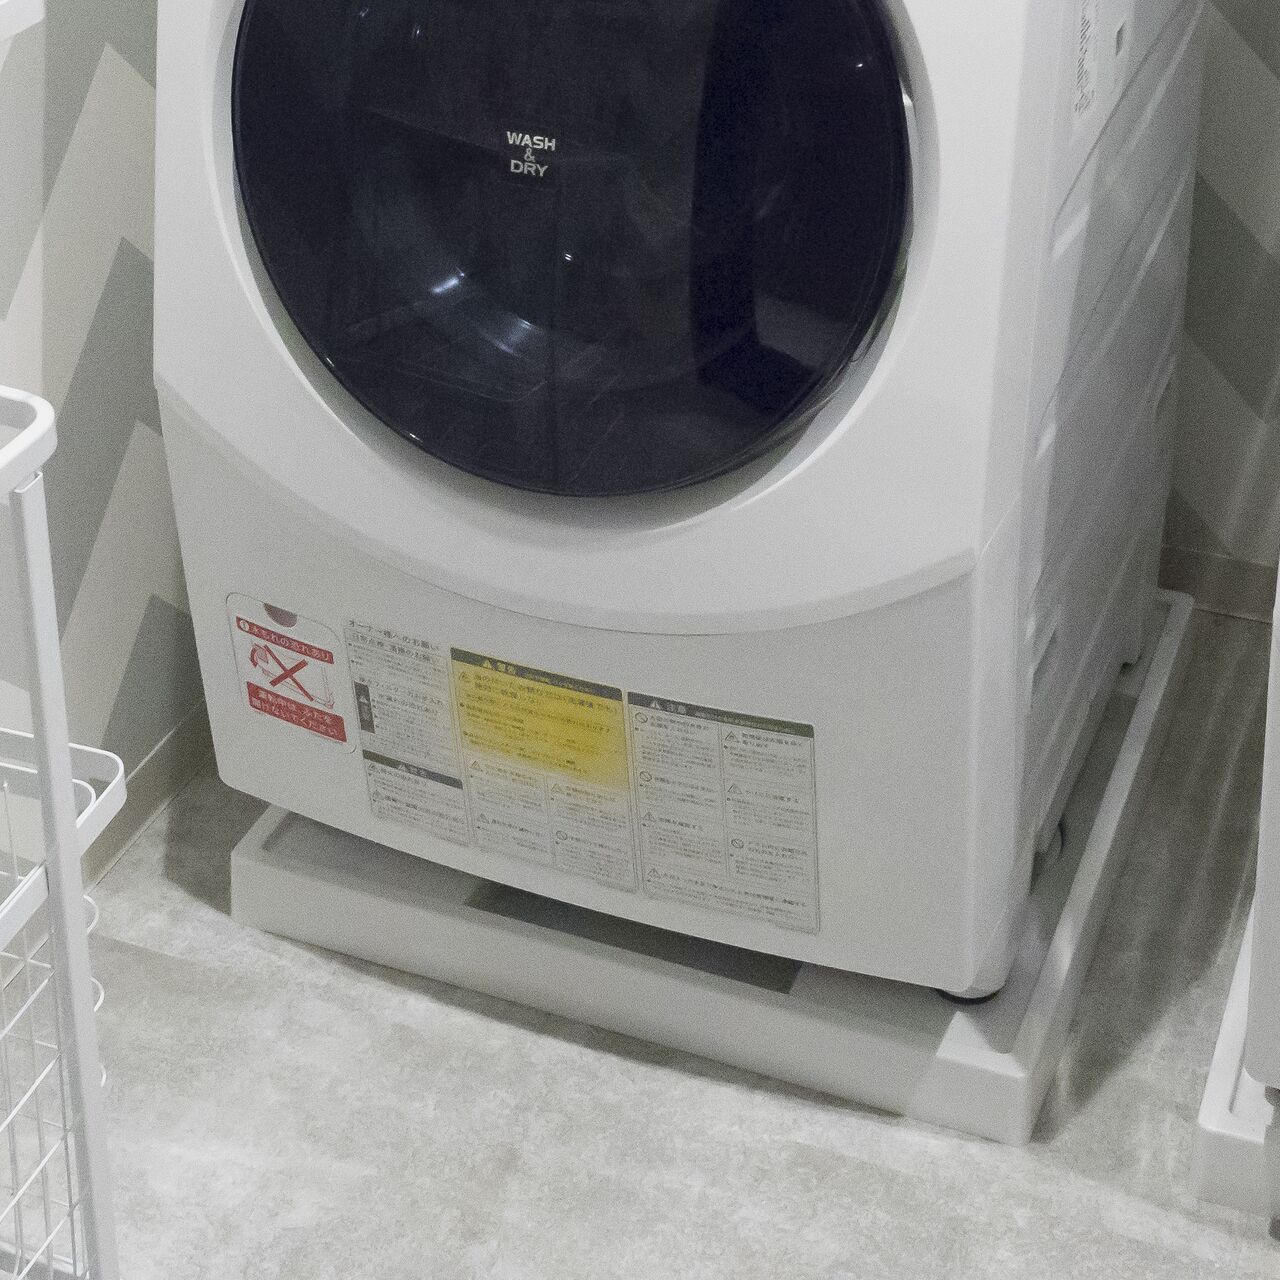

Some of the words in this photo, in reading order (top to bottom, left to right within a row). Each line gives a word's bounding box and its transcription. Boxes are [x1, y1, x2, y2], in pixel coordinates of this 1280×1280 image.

[506, 130, 556, 152] WASH
[524, 147, 536, 163] &
[510, 159, 549, 177] DRY
